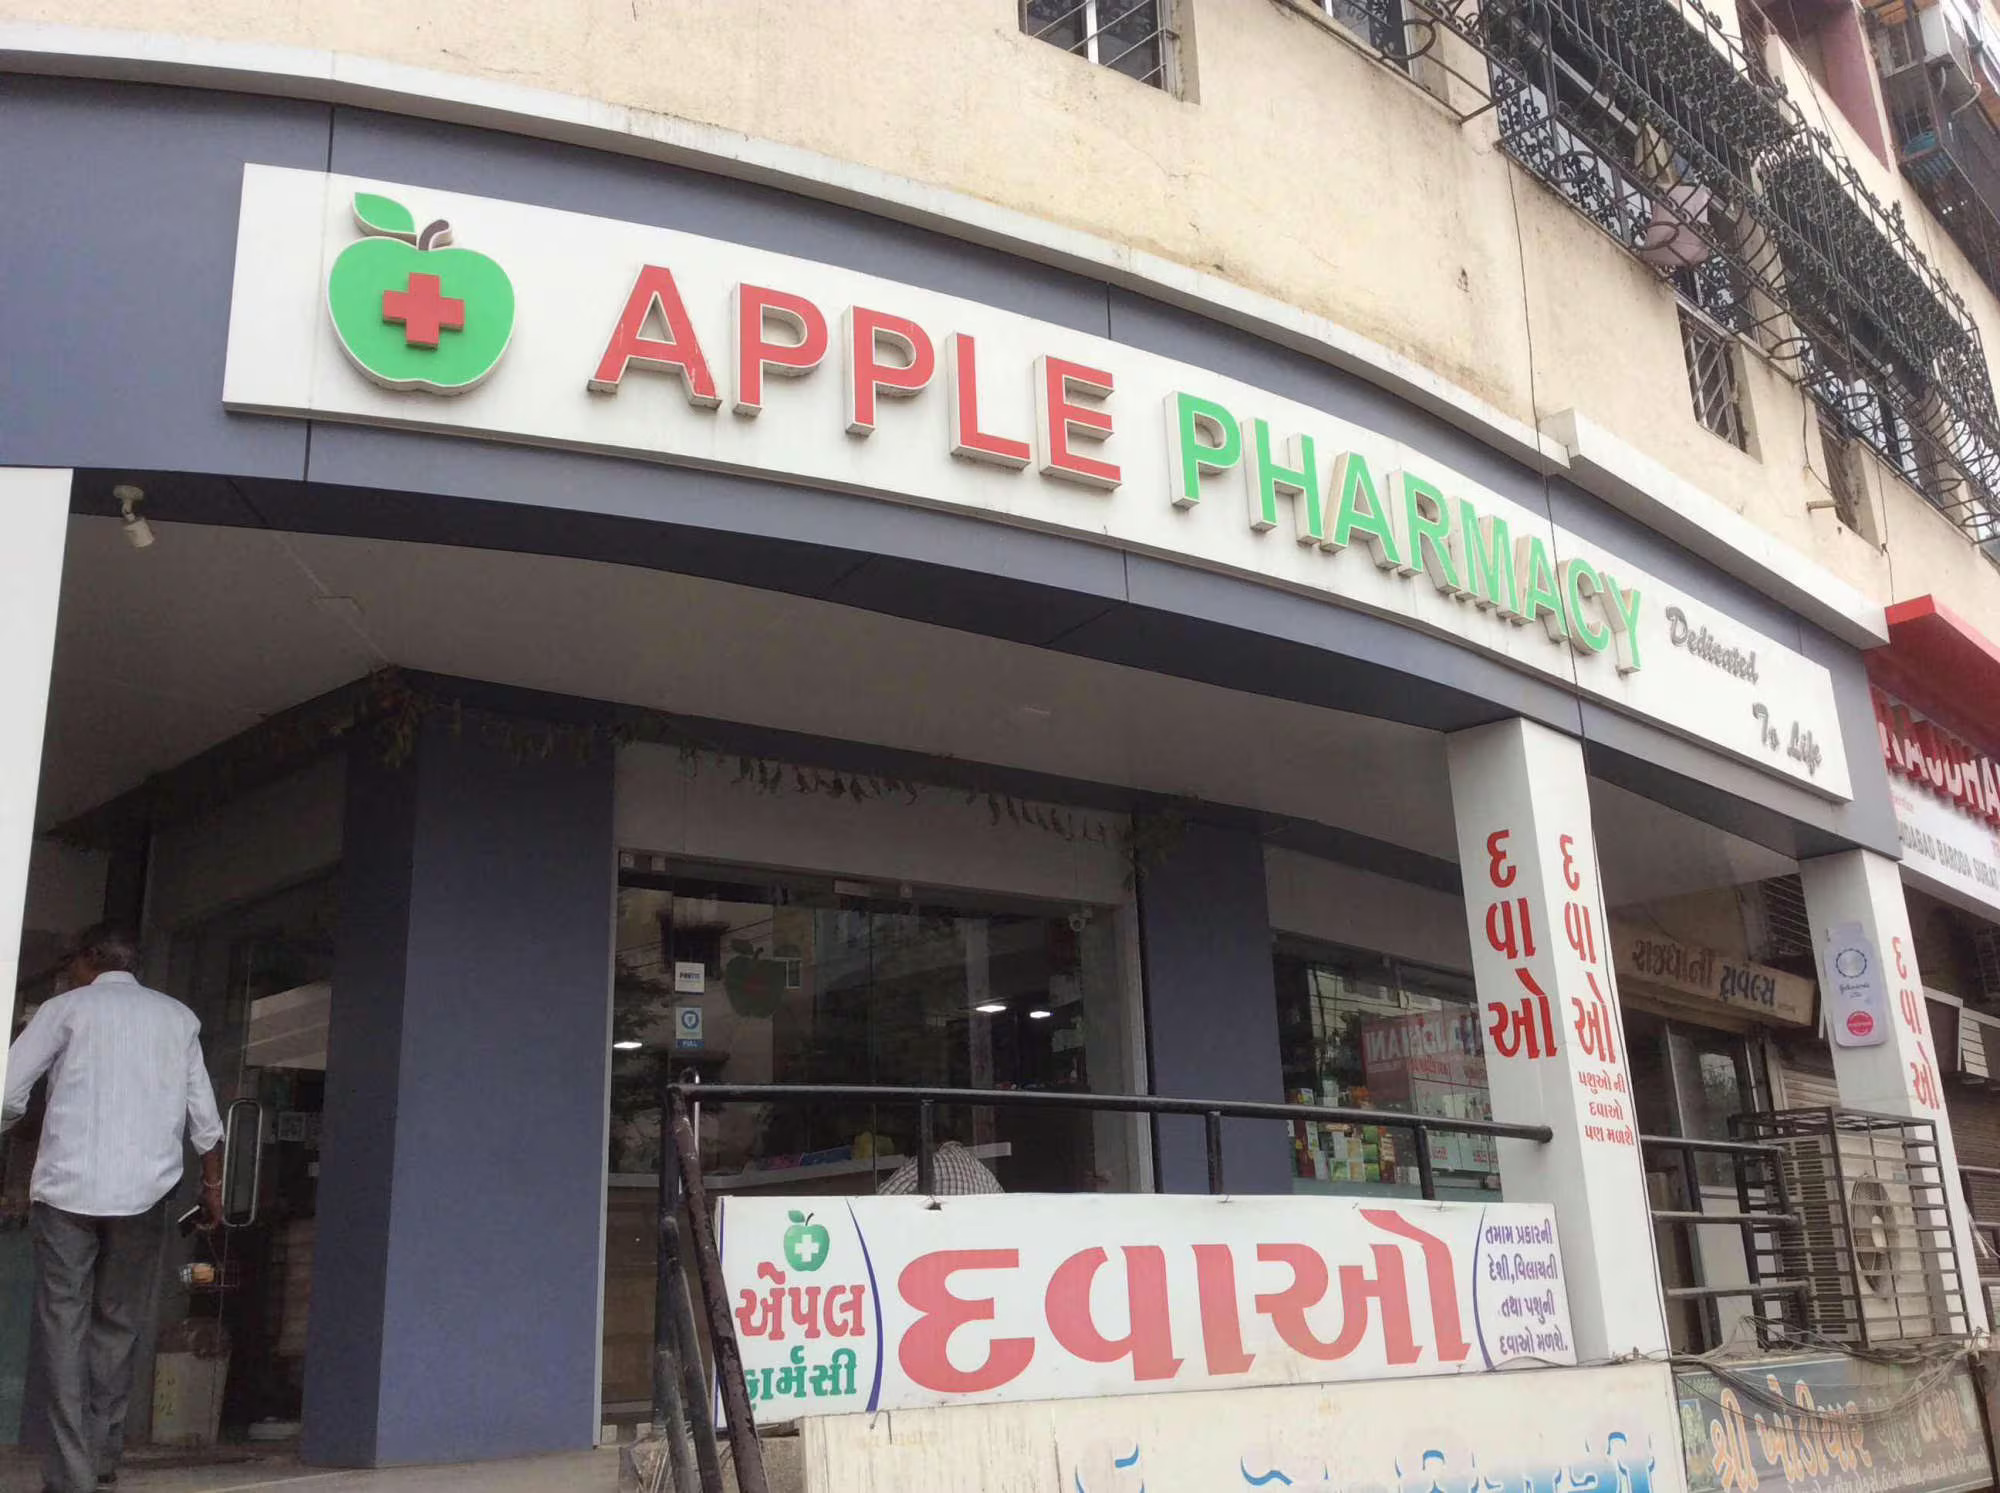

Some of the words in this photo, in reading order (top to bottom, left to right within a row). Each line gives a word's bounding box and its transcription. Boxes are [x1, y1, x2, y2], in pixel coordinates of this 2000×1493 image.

[588, 264, 1122, 490] APPLE
[1164, 391, 1641, 675] PHARMACY
[898, 1209, 1472, 1393] દવાઓ
